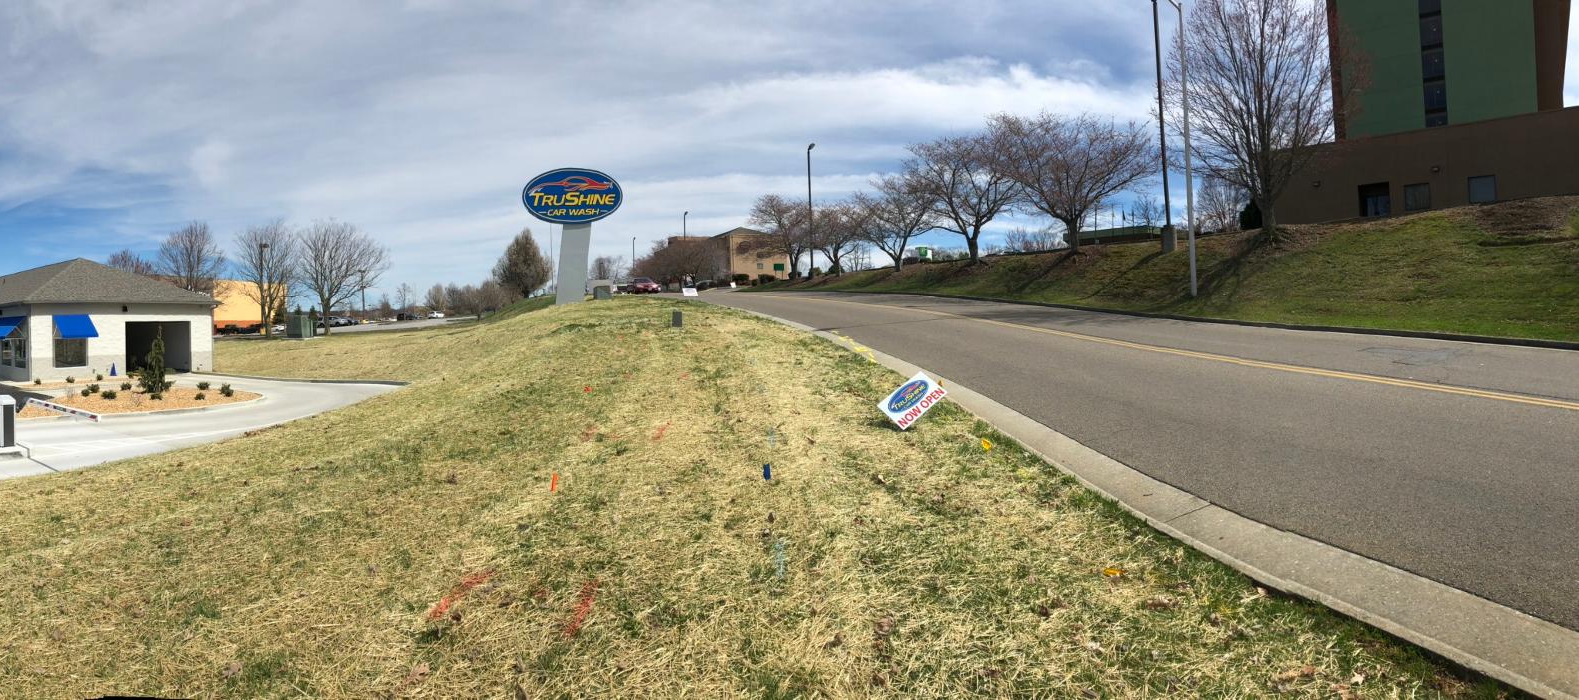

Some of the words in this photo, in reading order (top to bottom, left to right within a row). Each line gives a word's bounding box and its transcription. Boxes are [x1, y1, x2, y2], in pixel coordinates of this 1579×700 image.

[547, 208, 566, 216] CAR
[569, 208, 600, 216] WASH
[897, 405, 922, 428] NOW
[920, 387, 946, 409] OPEN
